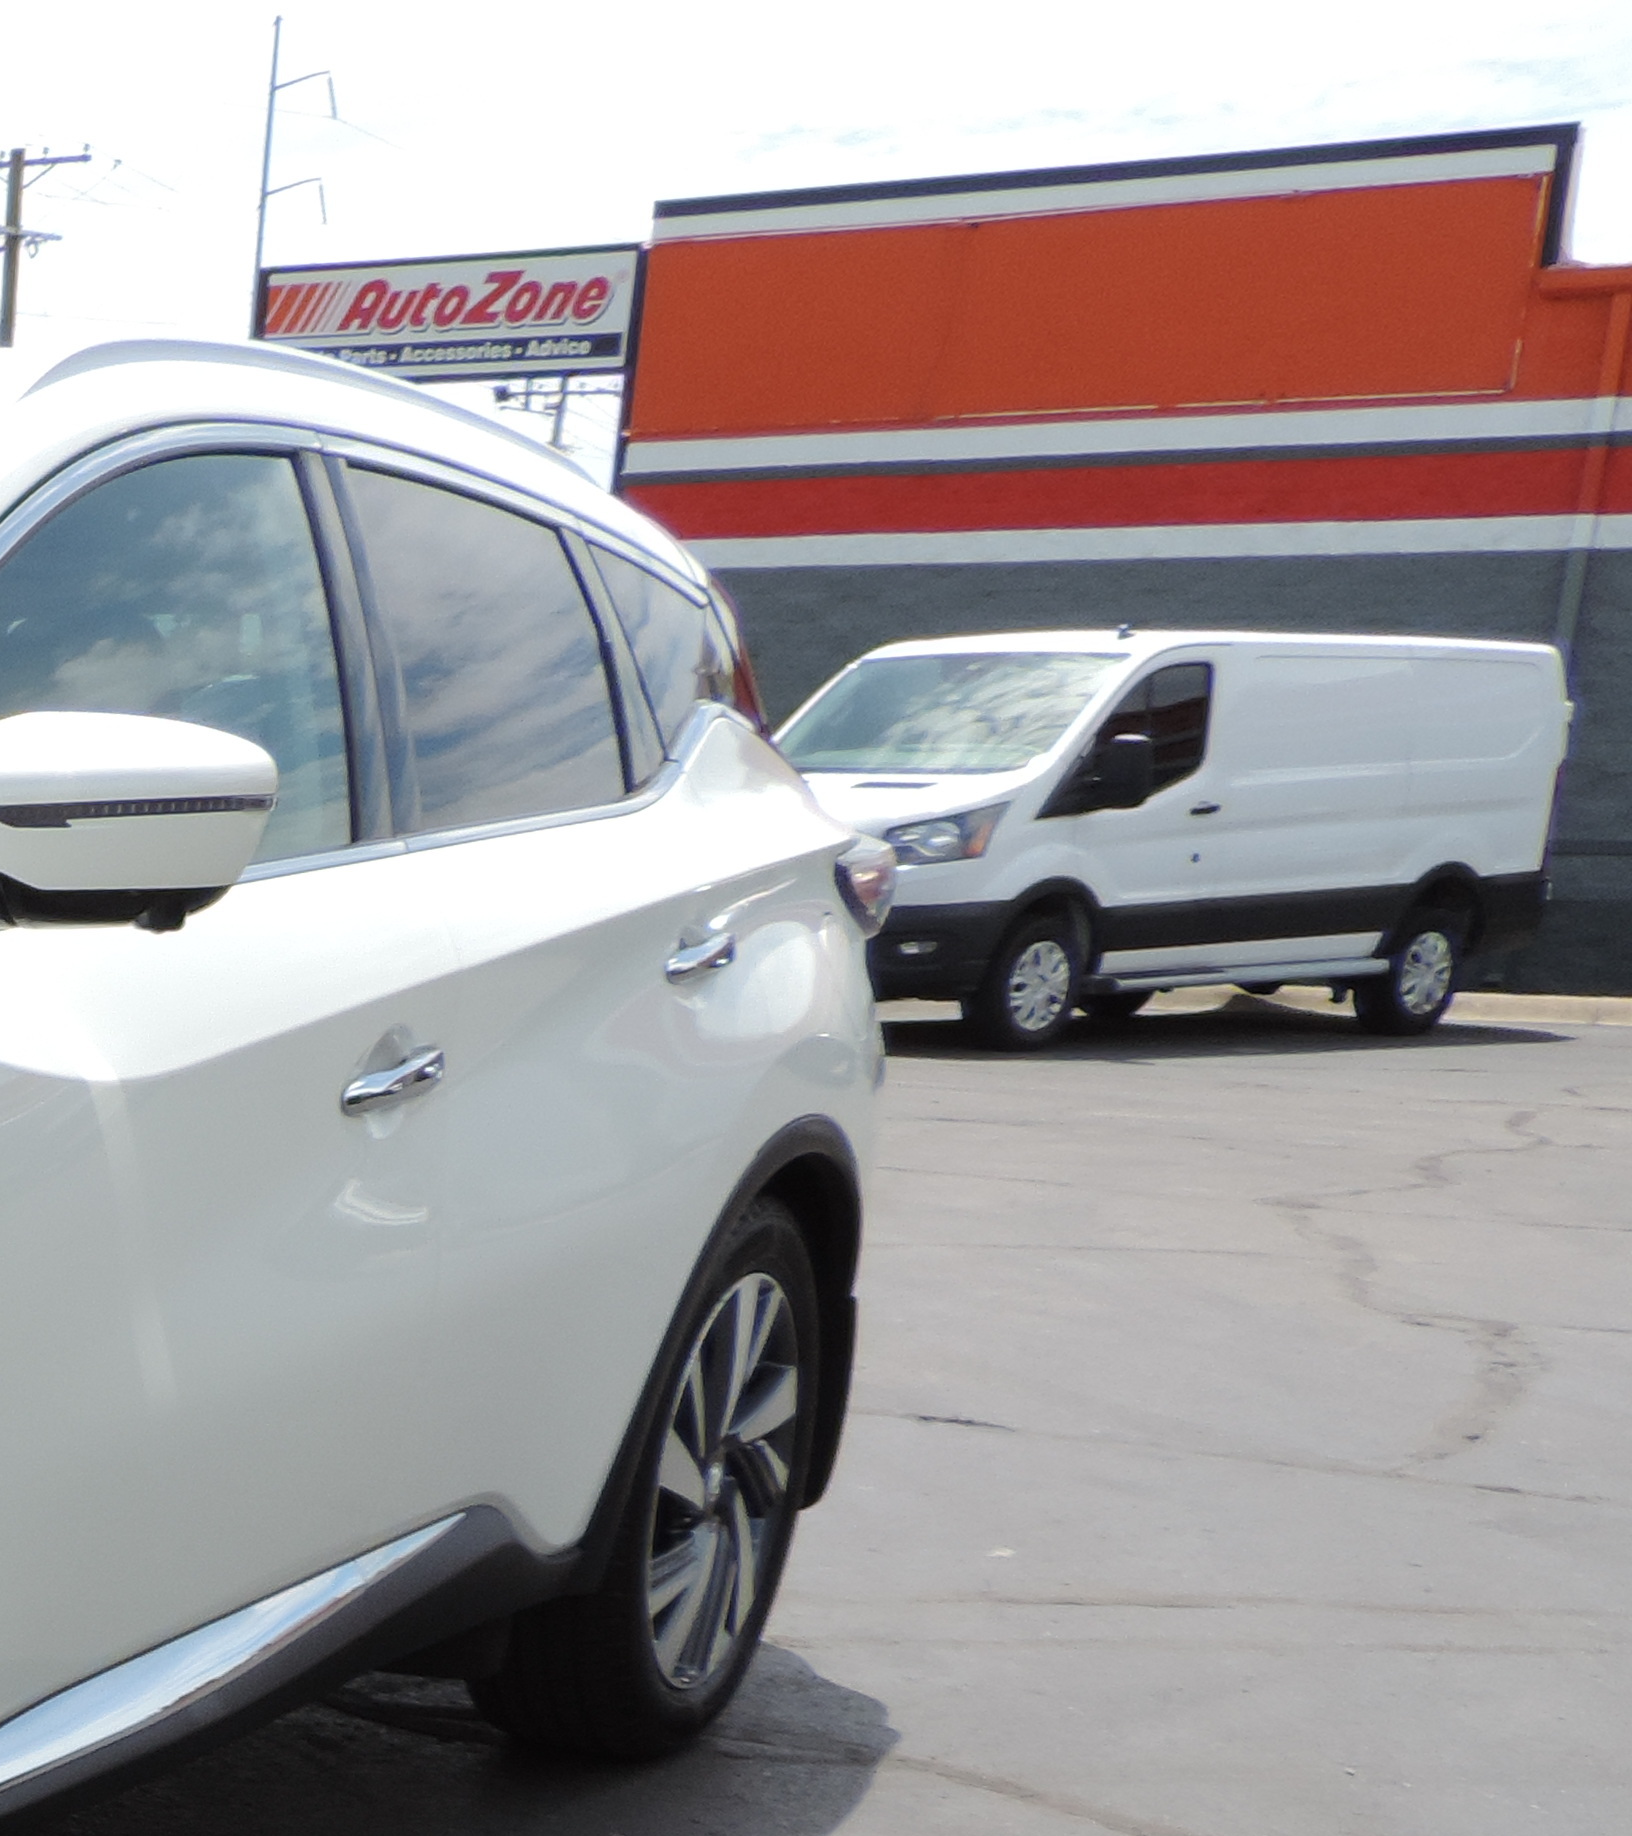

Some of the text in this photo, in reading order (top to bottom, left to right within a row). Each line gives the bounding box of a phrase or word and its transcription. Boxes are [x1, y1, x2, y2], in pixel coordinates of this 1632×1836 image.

[337, 268, 613, 332] AutoZone
[399, 340, 512, 363] Accessories
[524, 337, 592, 357] Advice
